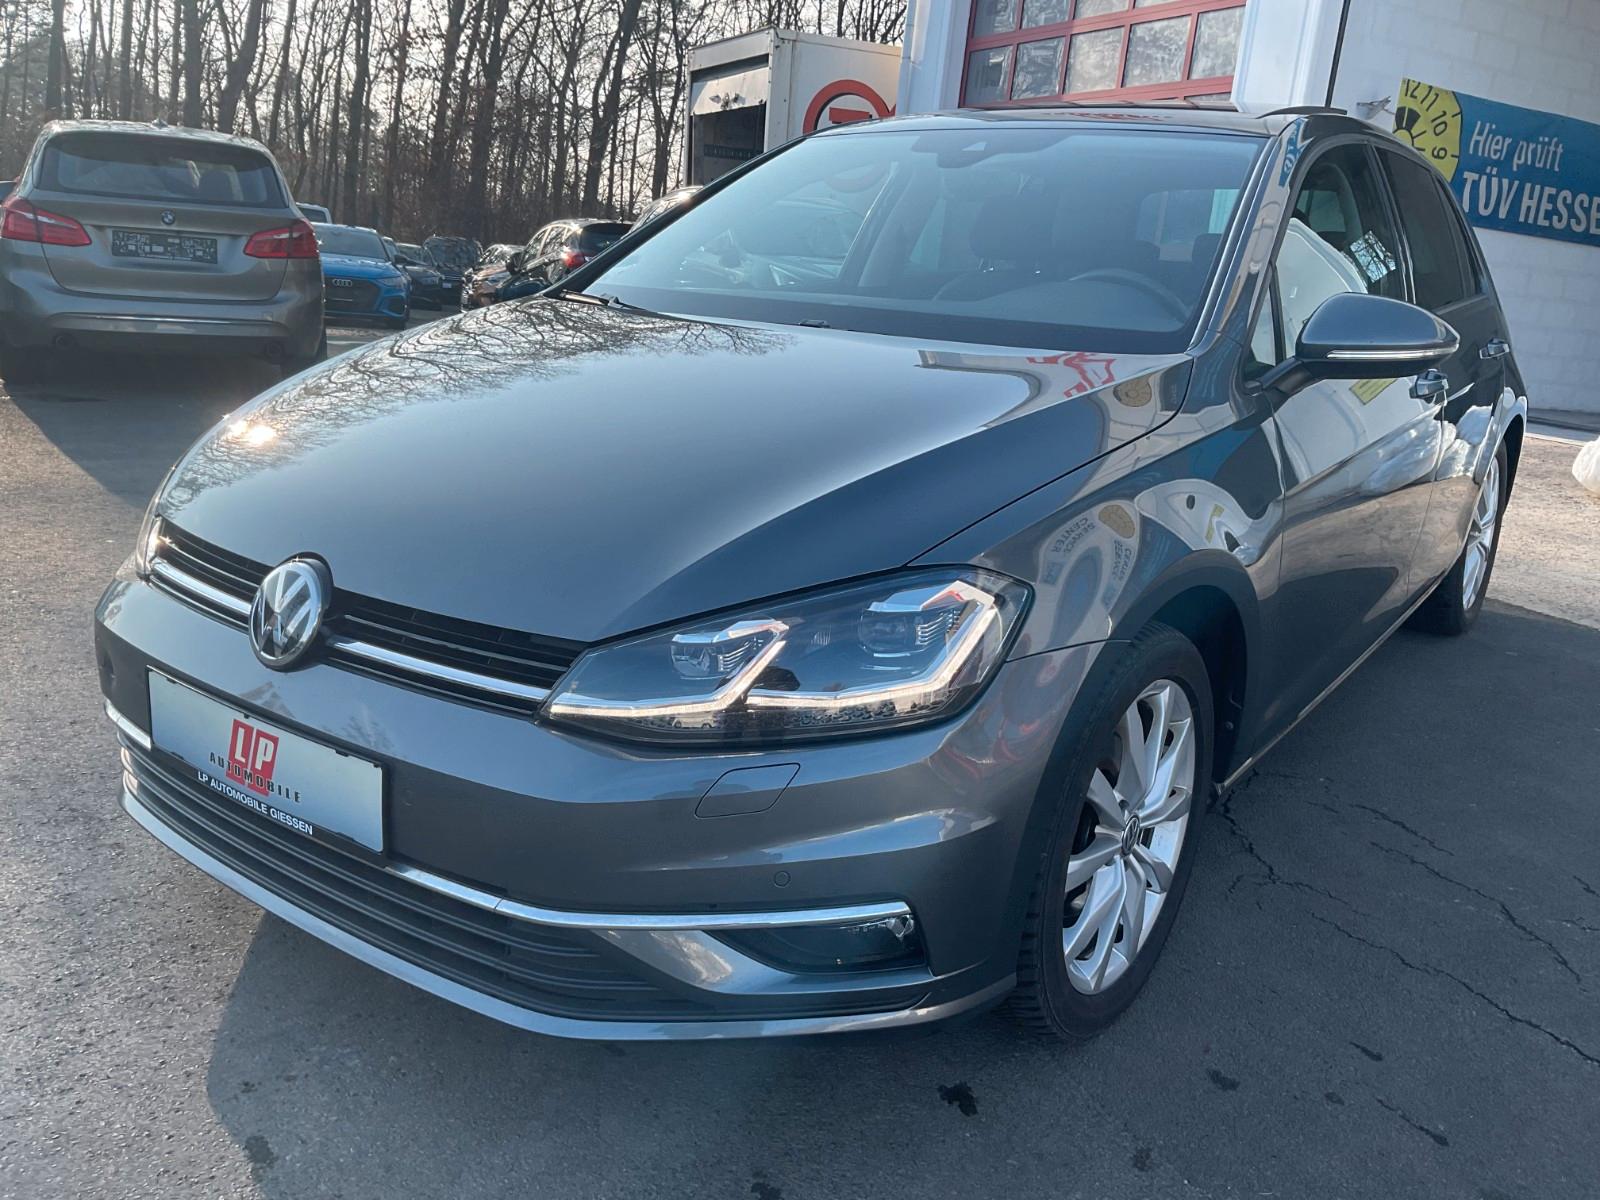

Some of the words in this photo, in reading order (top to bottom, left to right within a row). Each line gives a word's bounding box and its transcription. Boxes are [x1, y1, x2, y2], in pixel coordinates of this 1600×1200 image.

[1420, 85, 1440, 112] 11
[1431, 110, 1448, 136] 10
[1469, 120, 1513, 161] Hier
[1513, 137, 1563, 172] prüft
[1431, 145, 1448, 160] 9
[1462, 167, 1519, 219] TÜV
[234, 726, 275, 770] LP
[209, 751, 301, 803] AUTOMOBILE
[198, 771, 208, 782] LP
[210, 778, 268, 814] AUTOMOBILE
[270, 807, 313, 835] GIESSEN
